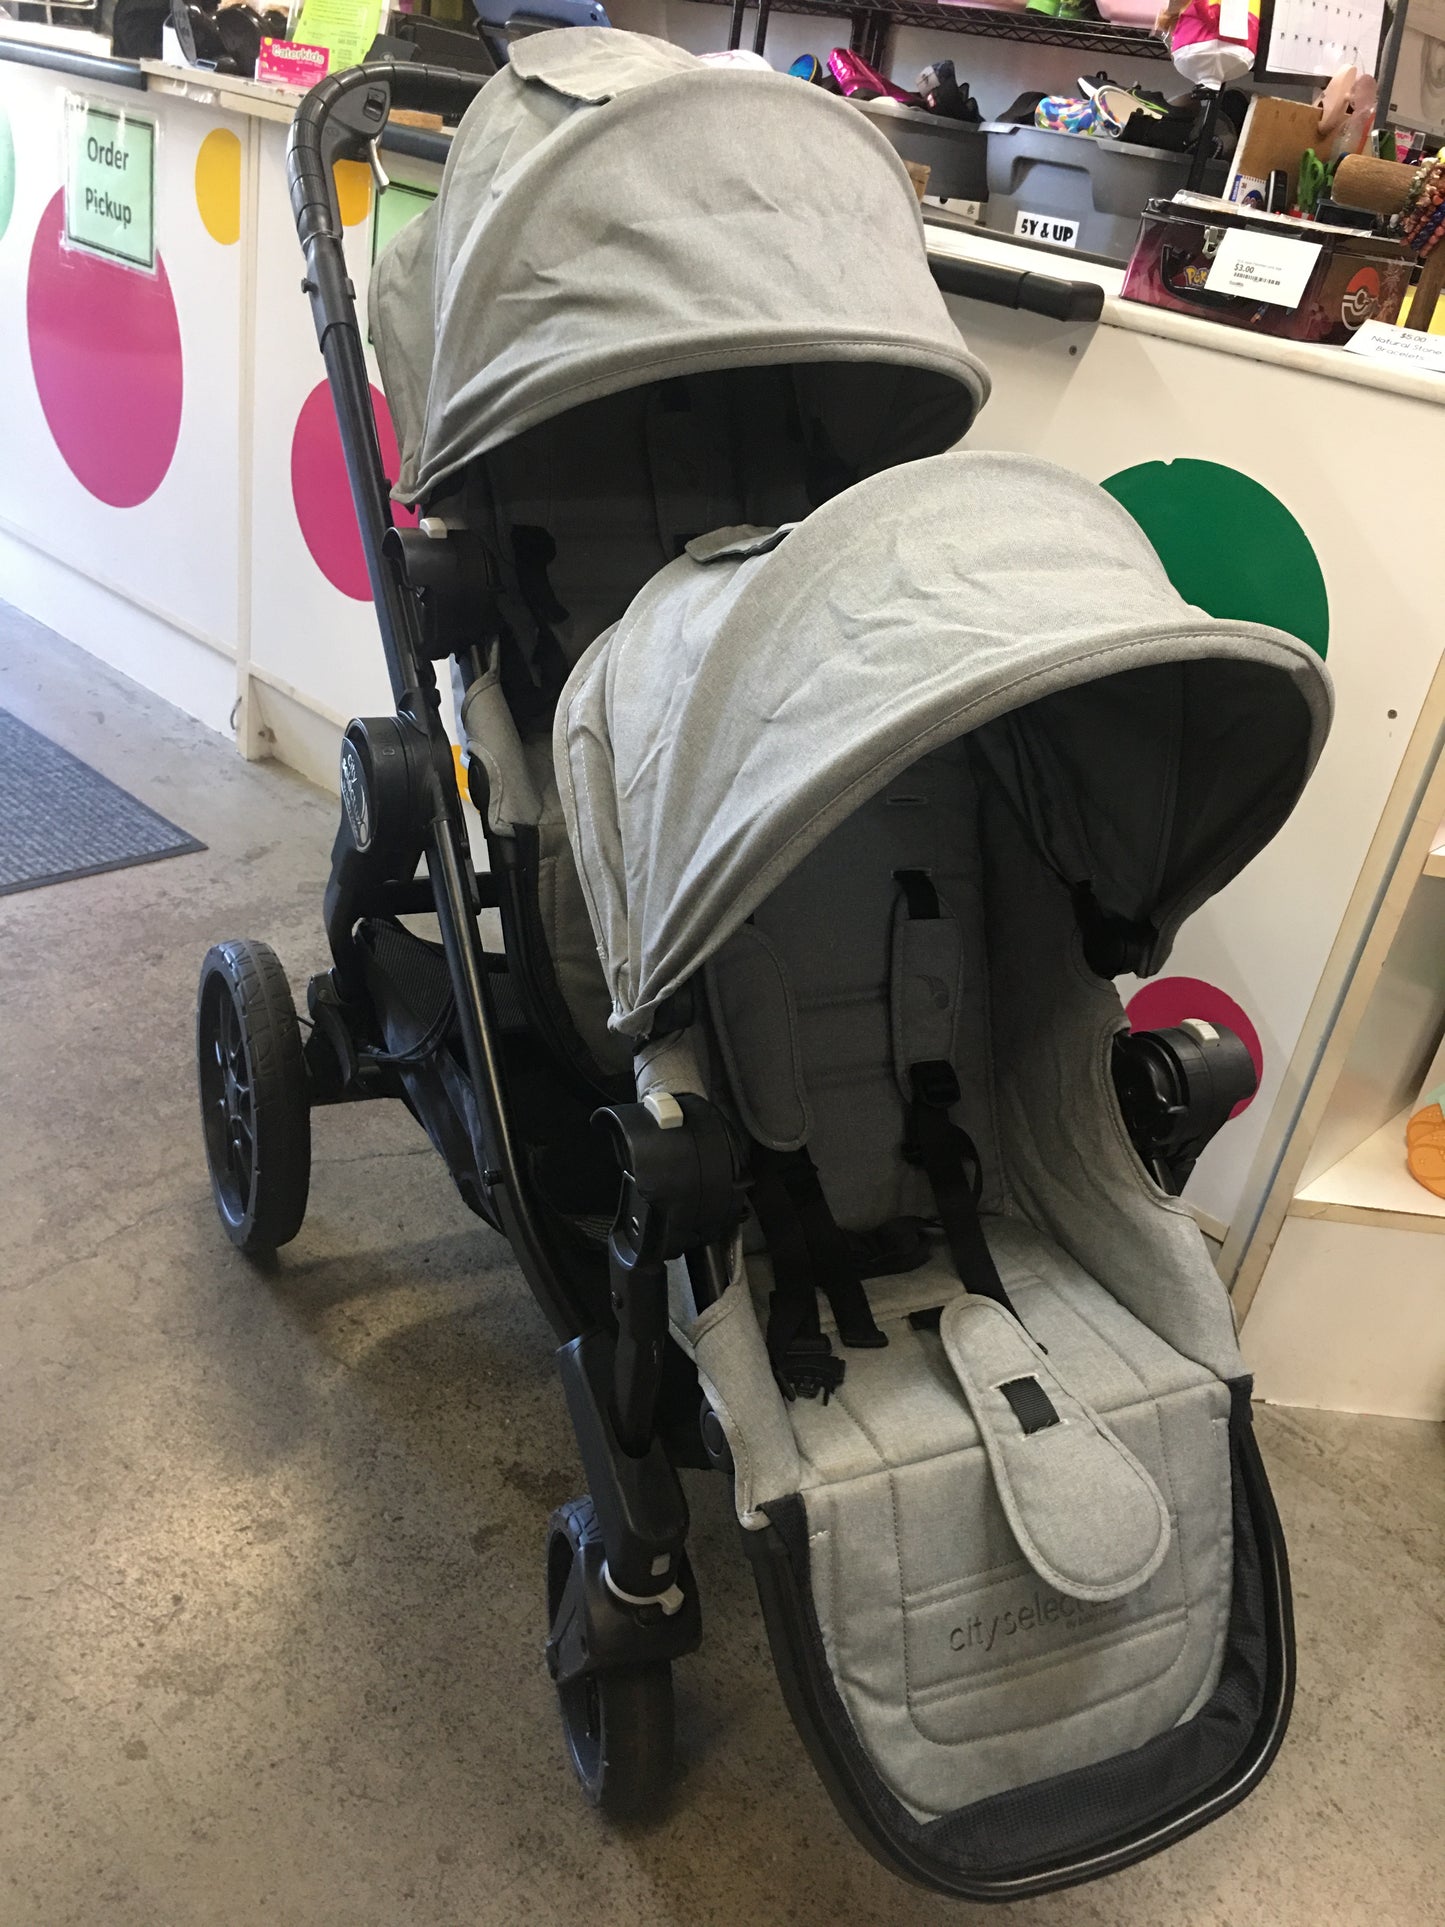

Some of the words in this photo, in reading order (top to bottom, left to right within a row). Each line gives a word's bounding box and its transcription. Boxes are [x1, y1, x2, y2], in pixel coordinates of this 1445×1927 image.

[87, 136, 129, 171] Order
[85, 187, 132, 230] Pickup
[1021, 218, 1039, 235] 5Y
[1040, 222, 1050, 238] &
[1053, 224, 1073, 242] UP
[1234, 263, 1255, 274] $3.00
[1371, 335, 1411, 349] Natural
[1412, 344, 1443, 355] Stone
[1375, 346, 1425, 360] Bracelets
